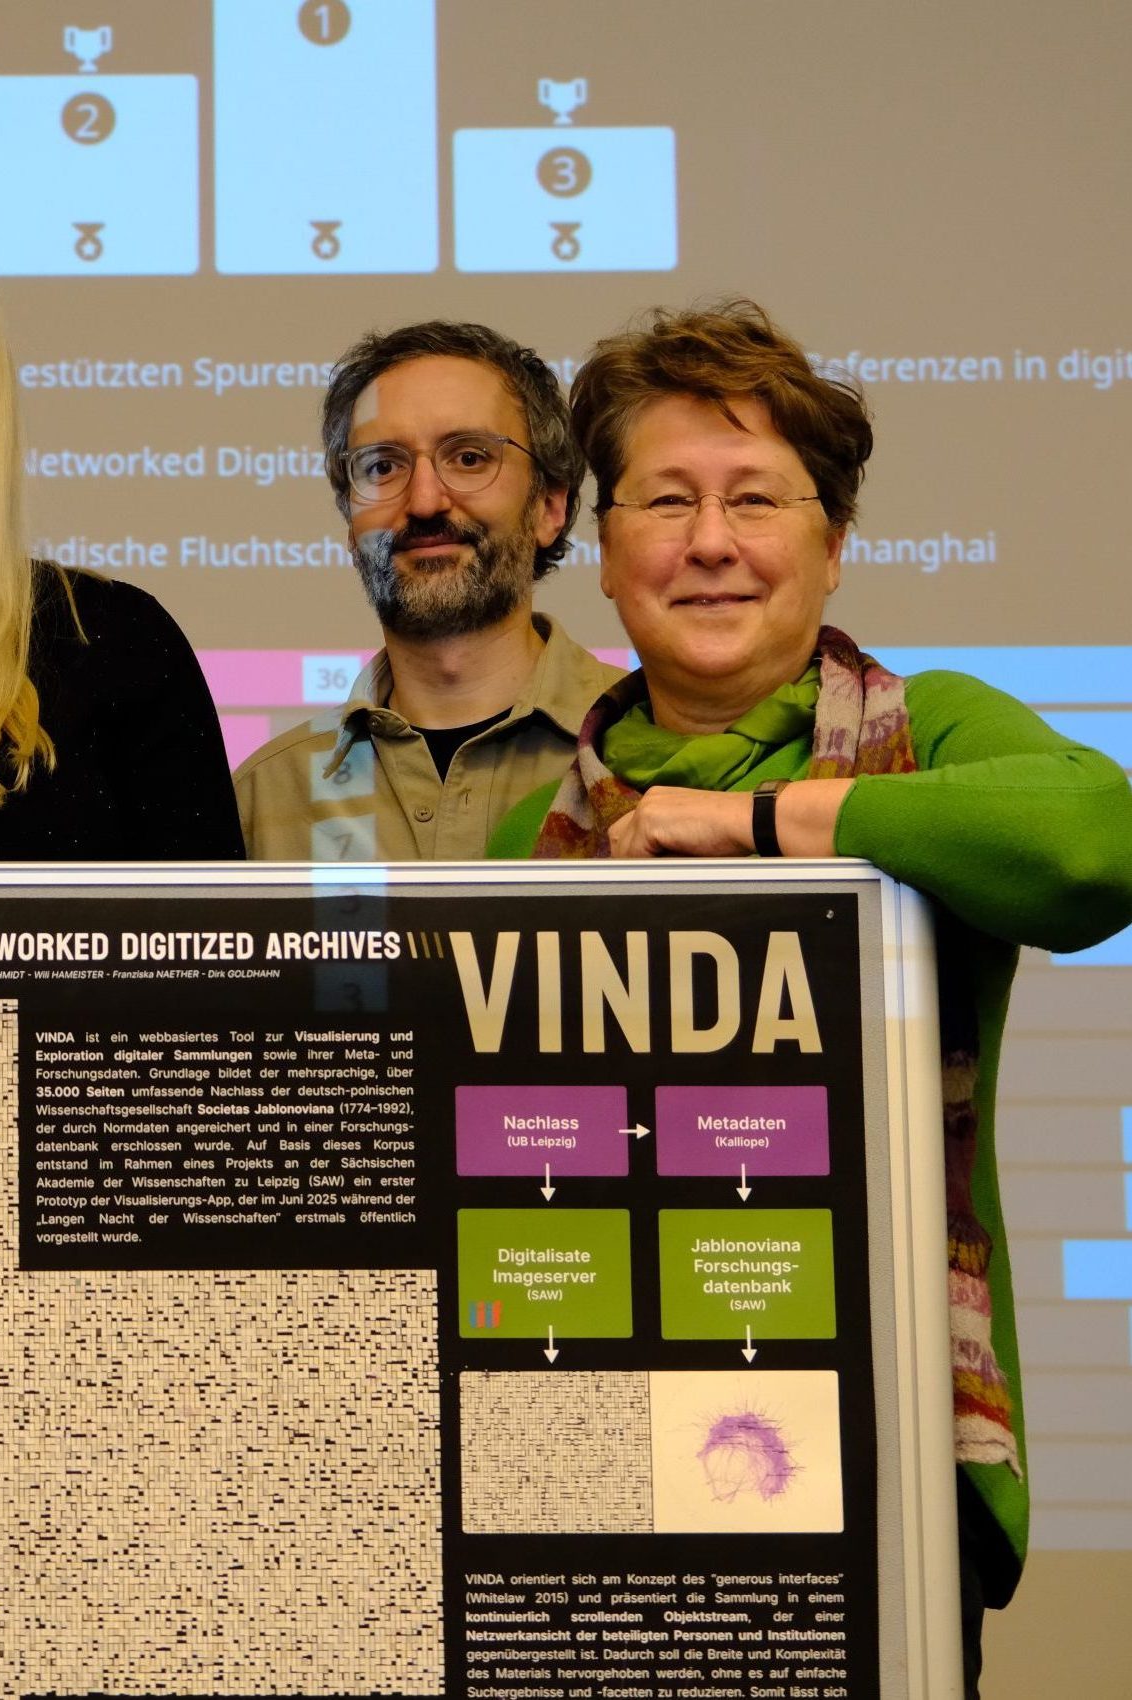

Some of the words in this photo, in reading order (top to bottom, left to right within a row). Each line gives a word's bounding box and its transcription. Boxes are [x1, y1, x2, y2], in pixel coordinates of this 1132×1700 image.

[313, 4, 334, 38] 1
[75, 103, 100, 138] 2
[552, 156, 577, 190] 3
[1014, 348, 1047, 380] in
[841, 531, 998, 574] hanghai
[317, 668, 348, 691] 36
[121, 931, 254, 961] DIGITIZED
[265, 930, 401, 961] ARCHIVES
[34, 970, 50, 980] Willi
[51, 969, 105, 980] HAMEISTER
[112, 969, 155, 979] Franziska
[155, 969, 200, 979] NAETHER
[207, 969, 226, 979] Dirk
[227, 968, 281, 979] GOLDHAHN
[448, 930, 823, 1053] VINDA
[35, 1031, 75, 1044] VINDA
[85, 1032, 100, 1044] ist
[110, 1031, 129, 1043] ein
[138, 1031, 219, 1044] webbasiertes
[229, 1030, 255, 1042] Tool
[265, 1032, 284, 1042] zur
[294, 1030, 380, 1045] Visualisierung
[389, 1030, 414, 1042] und
[35, 1049, 104, 1064] Exploration
[113, 1049, 164, 1064] digitaler
[173, 1048, 253, 1063] Sammlungen
[263, 1048, 298, 1060] sowie
[307, 1048, 335, 1060] ihrer
[344, 1048, 380, 1060] Meta-
[390, 1048, 414, 1060] und
[35, 1068, 141, 1082] Forschungsdaten.
[149, 1067, 211, 1082] Grundlage
[218, 1066, 252, 1079] bildet
[259, 1067, 280, 1078] der
[287, 1066, 379, 1081] mehrsprachige,
[386, 1066, 414, 1078] über
[36, 1086, 80, 1098] 35.000
[86, 1085, 125, 1098] Seiten
[131, 1085, 204, 1098] umfassende
[210, 1085, 265, 1098] Nachlass
[270, 1085, 291, 1097] der
[297, 1084, 414, 1098] deutsch-polnischen
[35, 1103, 193, 1118] Wissenschaftsgesellschaft
[197, 1103, 251, 1116] Societas
[254, 1102, 335, 1116] Jablonoviana
[35, 1122, 57, 1135] der
[62, 1122, 97, 1134] durch
[103, 1122, 170, 1134] Normdaten
[176, 1121, 251, 1136] angereichert
[257, 1122, 281, 1134] und
[286, 1120, 298, 1132] in
[303, 1120, 334, 1133] einer
[340, 1120, 415, 1135] Forschungs-
[503, 1115, 579, 1130] Nachlass
[697, 1116, 786, 1131] Metadaten
[507, 1135, 529, 1147] (UB
[530, 1135, 577, 1149] Leipzig)
[715, 1135, 769, 1149] (Kalliope)
[691, 1238, 801, 1253] Jablonoviana
[498, 1248, 591, 1266] Digitalisate
[694, 1258, 799, 1276] Forschungs-
[493, 1268, 597, 1286] Imageserver
[703, 1279, 792, 1294] datenbank
[527, 1289, 563, 1301] (SAW)
[729, 1298, 766, 1311] (SAW)
[464, 1573, 505, 1586] VINDA
[510, 1573, 566, 1586] orientiert
[571, 1573, 597, 1586] sich
[602, 1575, 622, 1586] am
[626, 1573, 677, 1588] Konzept
[682, 1573, 706, 1586] des
[465, 1610, 551, 1623] kontinuierlich
[570, 1610, 644, 1623] scrollenden
[663, 1610, 752, 1625] Objektstream,
[772, 1610, 794, 1623] der
[814, 1610, 845, 1623] einer
